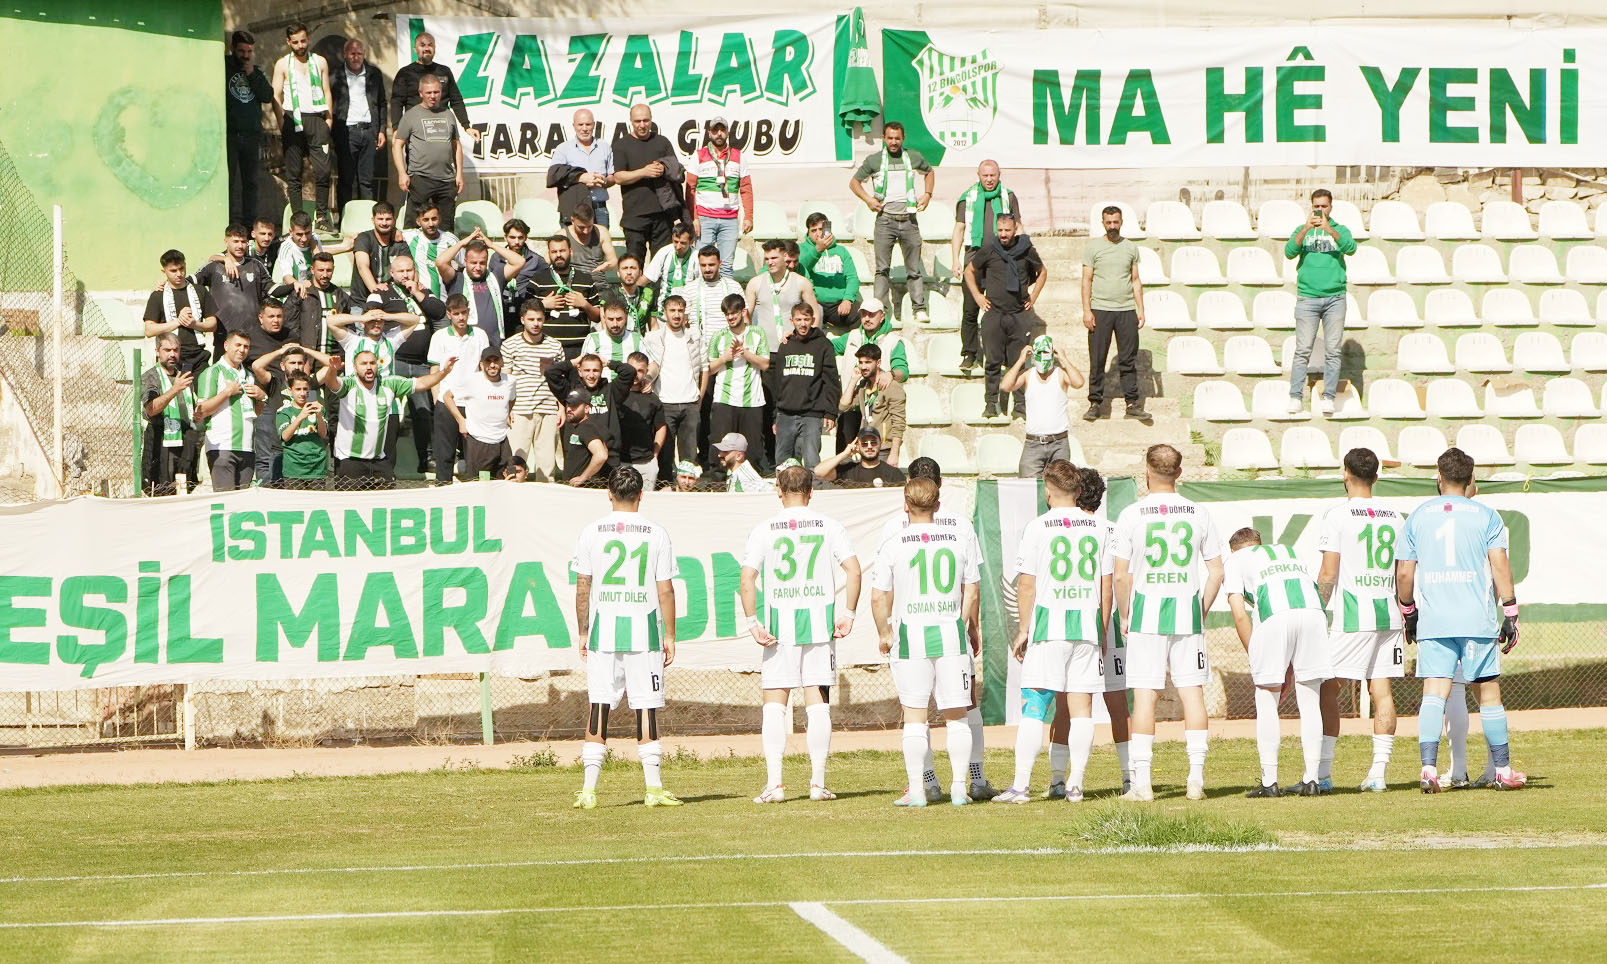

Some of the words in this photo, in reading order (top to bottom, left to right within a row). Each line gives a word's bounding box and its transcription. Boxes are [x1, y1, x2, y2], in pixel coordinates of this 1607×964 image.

[455, 30, 818, 108] ZAZALAR
[927, 81, 938, 94] 12
[1032, 68, 1171, 146] MA
[1204, 46, 1327, 144] HÊ
[1359, 47, 1579, 146] YENİ
[677, 118, 804, 156] GUBU
[953, 139, 968, 147] 2012
[1140, 506, 1159, 515] HAUS
[1351, 508, 1368, 517] HAUS
[597, 524, 616, 533] HAUS
[770, 521, 788, 531] HAUS
[1044, 519, 1063, 528] HAUS
[209, 503, 503, 563] İSTANBUL
[901, 534, 921, 543] HAUS
[1145, 521, 1193, 568] 53
[1358, 523, 1396, 570] 18
[1435, 517, 1457, 568] 1
[601, 539, 649, 587] 21
[773, 534, 825, 582] 37
[1050, 535, 1099, 582] 88
[909, 547, 956, 595] 10
[1146, 572, 1188, 584] EREN
[624, 589, 648, 603] DİLEK
[773, 587, 800, 599] FARUK
[1052, 585, 1092, 600] YİĞİT
[907, 602, 935, 615] OSMAN
